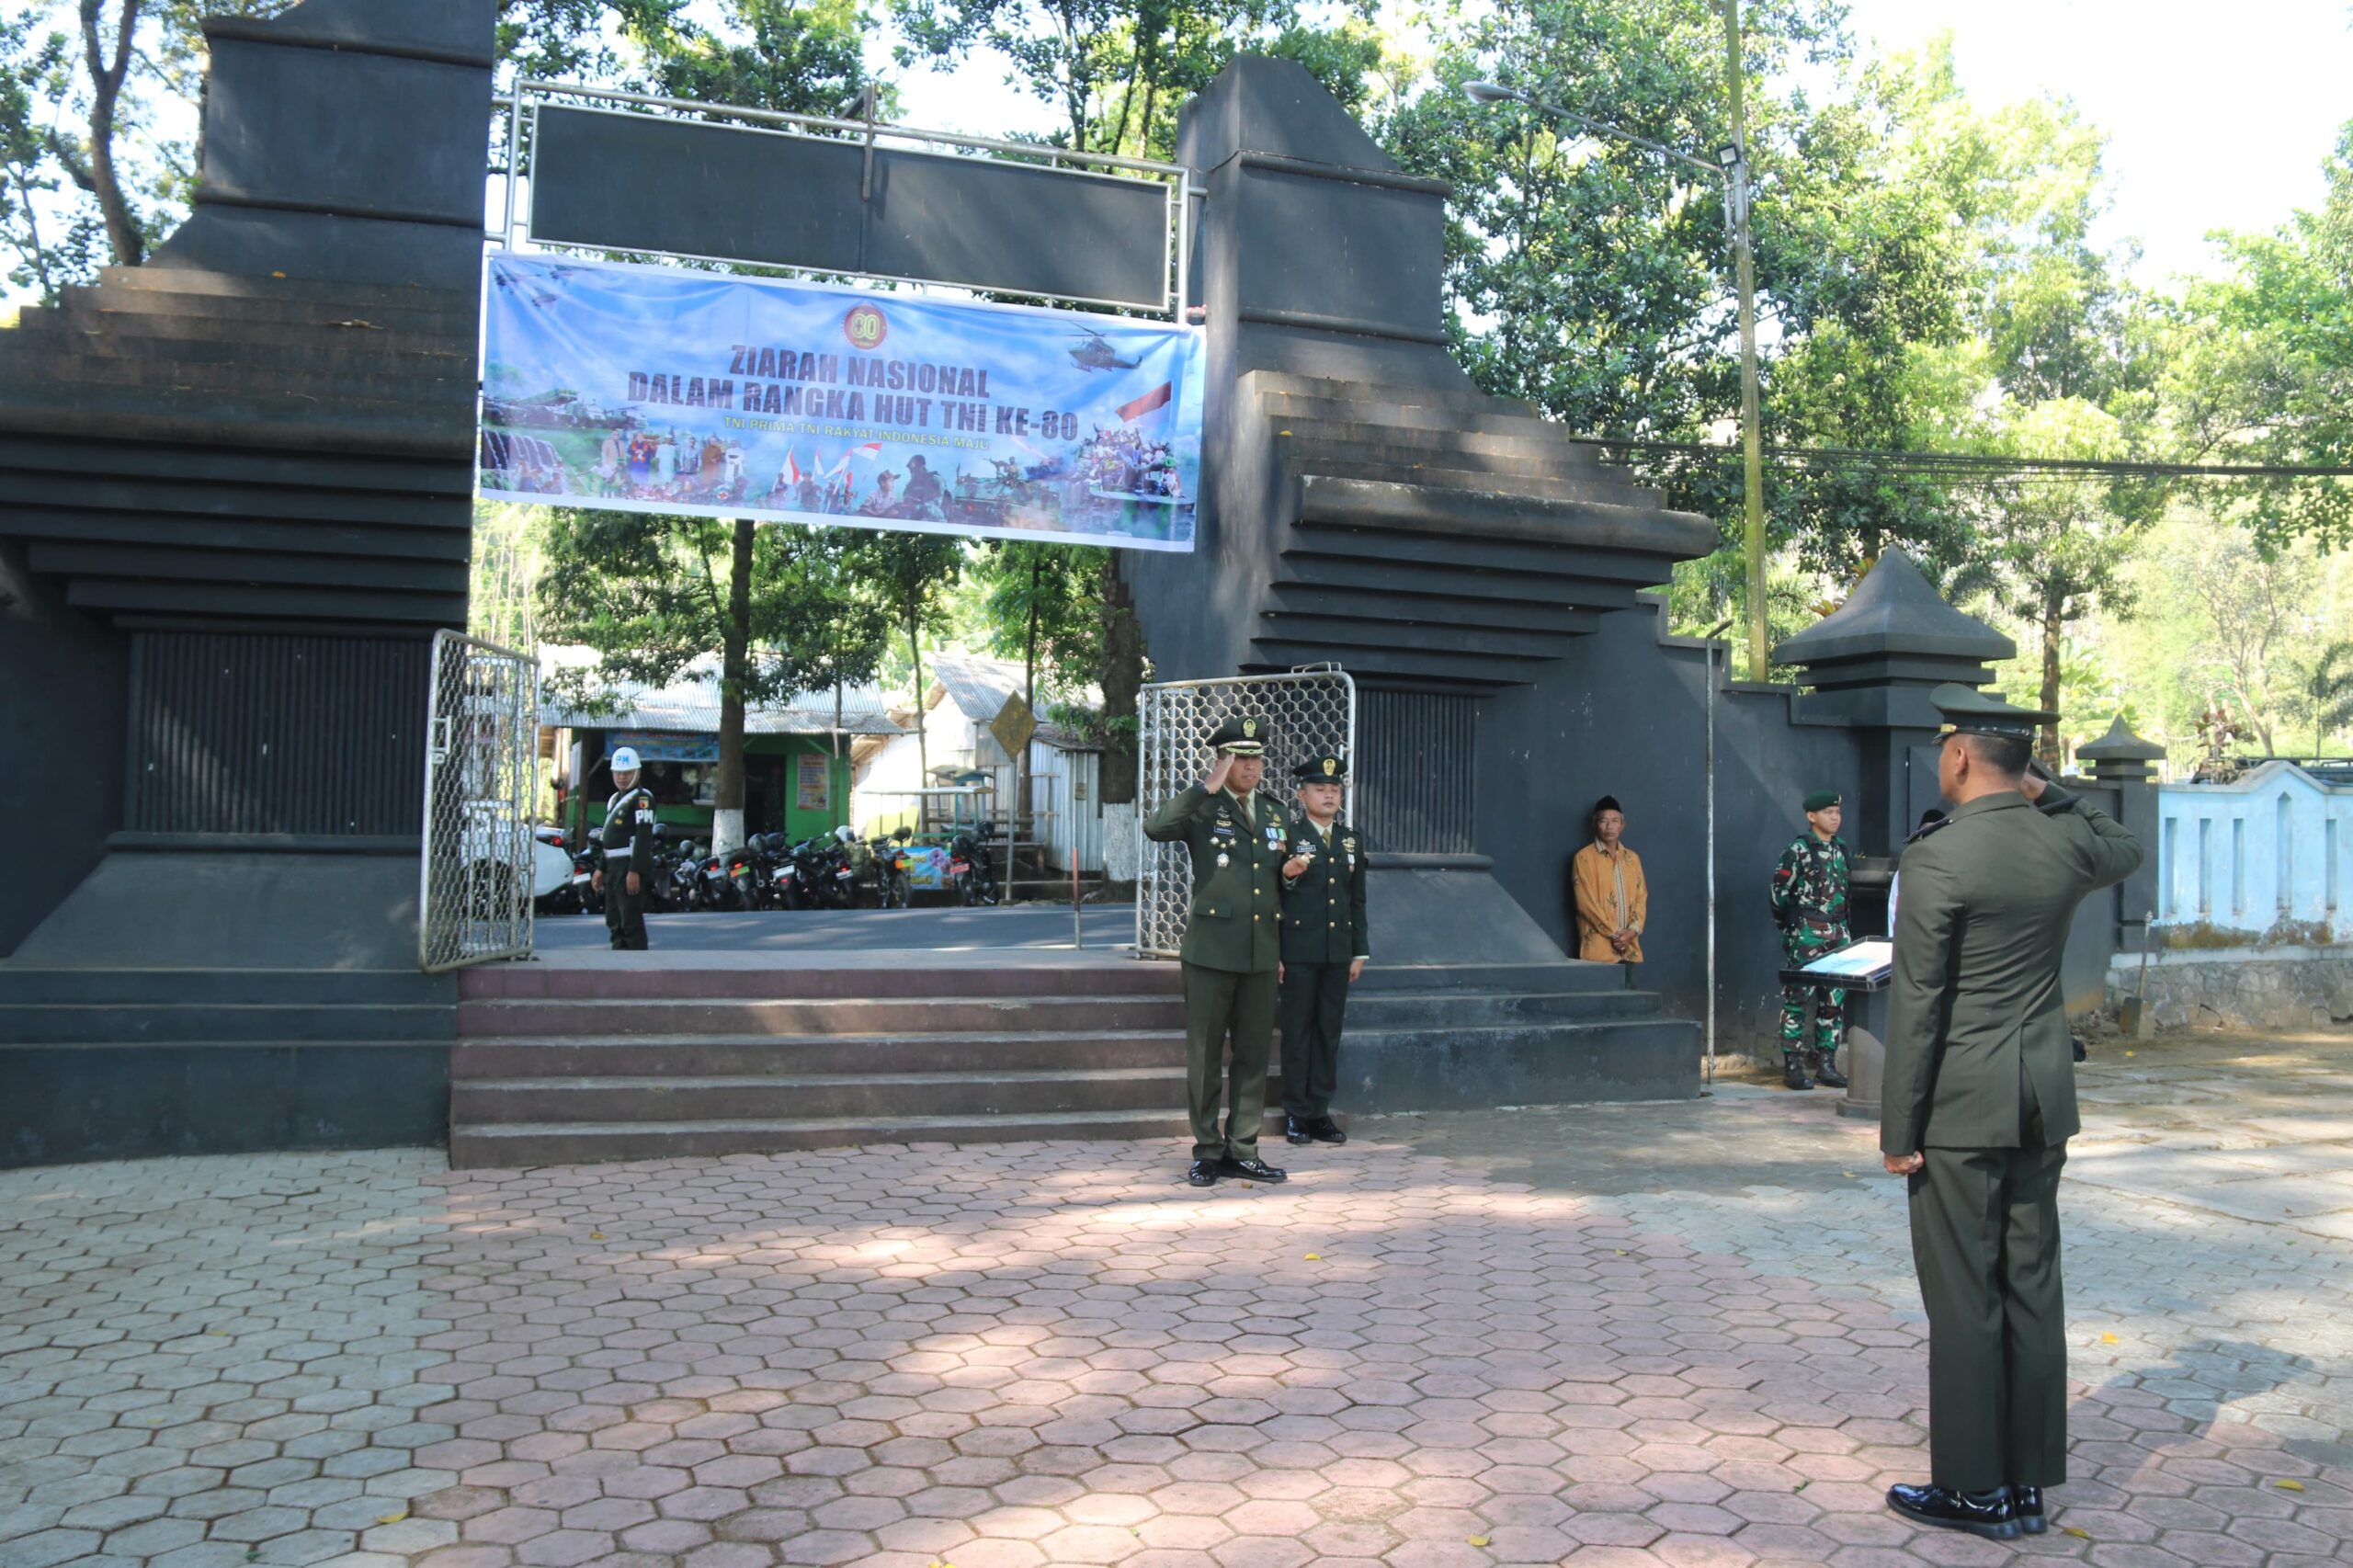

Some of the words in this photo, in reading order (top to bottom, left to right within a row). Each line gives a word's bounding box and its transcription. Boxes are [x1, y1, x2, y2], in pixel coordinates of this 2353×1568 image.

[852, 313, 881, 339] 80
[730, 345, 838, 383] ZIARAH
[847, 357, 990, 398] NASIONAL
[628, 371, 733, 410] DALAM
[743, 381, 865, 421] RANGKA
[874, 393, 932, 427] HUT
[940, 401, 987, 433] TNI
[995, 405, 1078, 441] KE-80
[724, 416, 745, 429] TNI
[749, 419, 795, 433] PRIMA
[800, 423, 820, 436] TNI
[824, 426, 874, 439] RAKYAT
[879, 430, 949, 447] INDONESIA
[954, 437, 989, 450] MAJU
[616, 755, 630, 766] PM
[635, 809, 654, 824] PM
